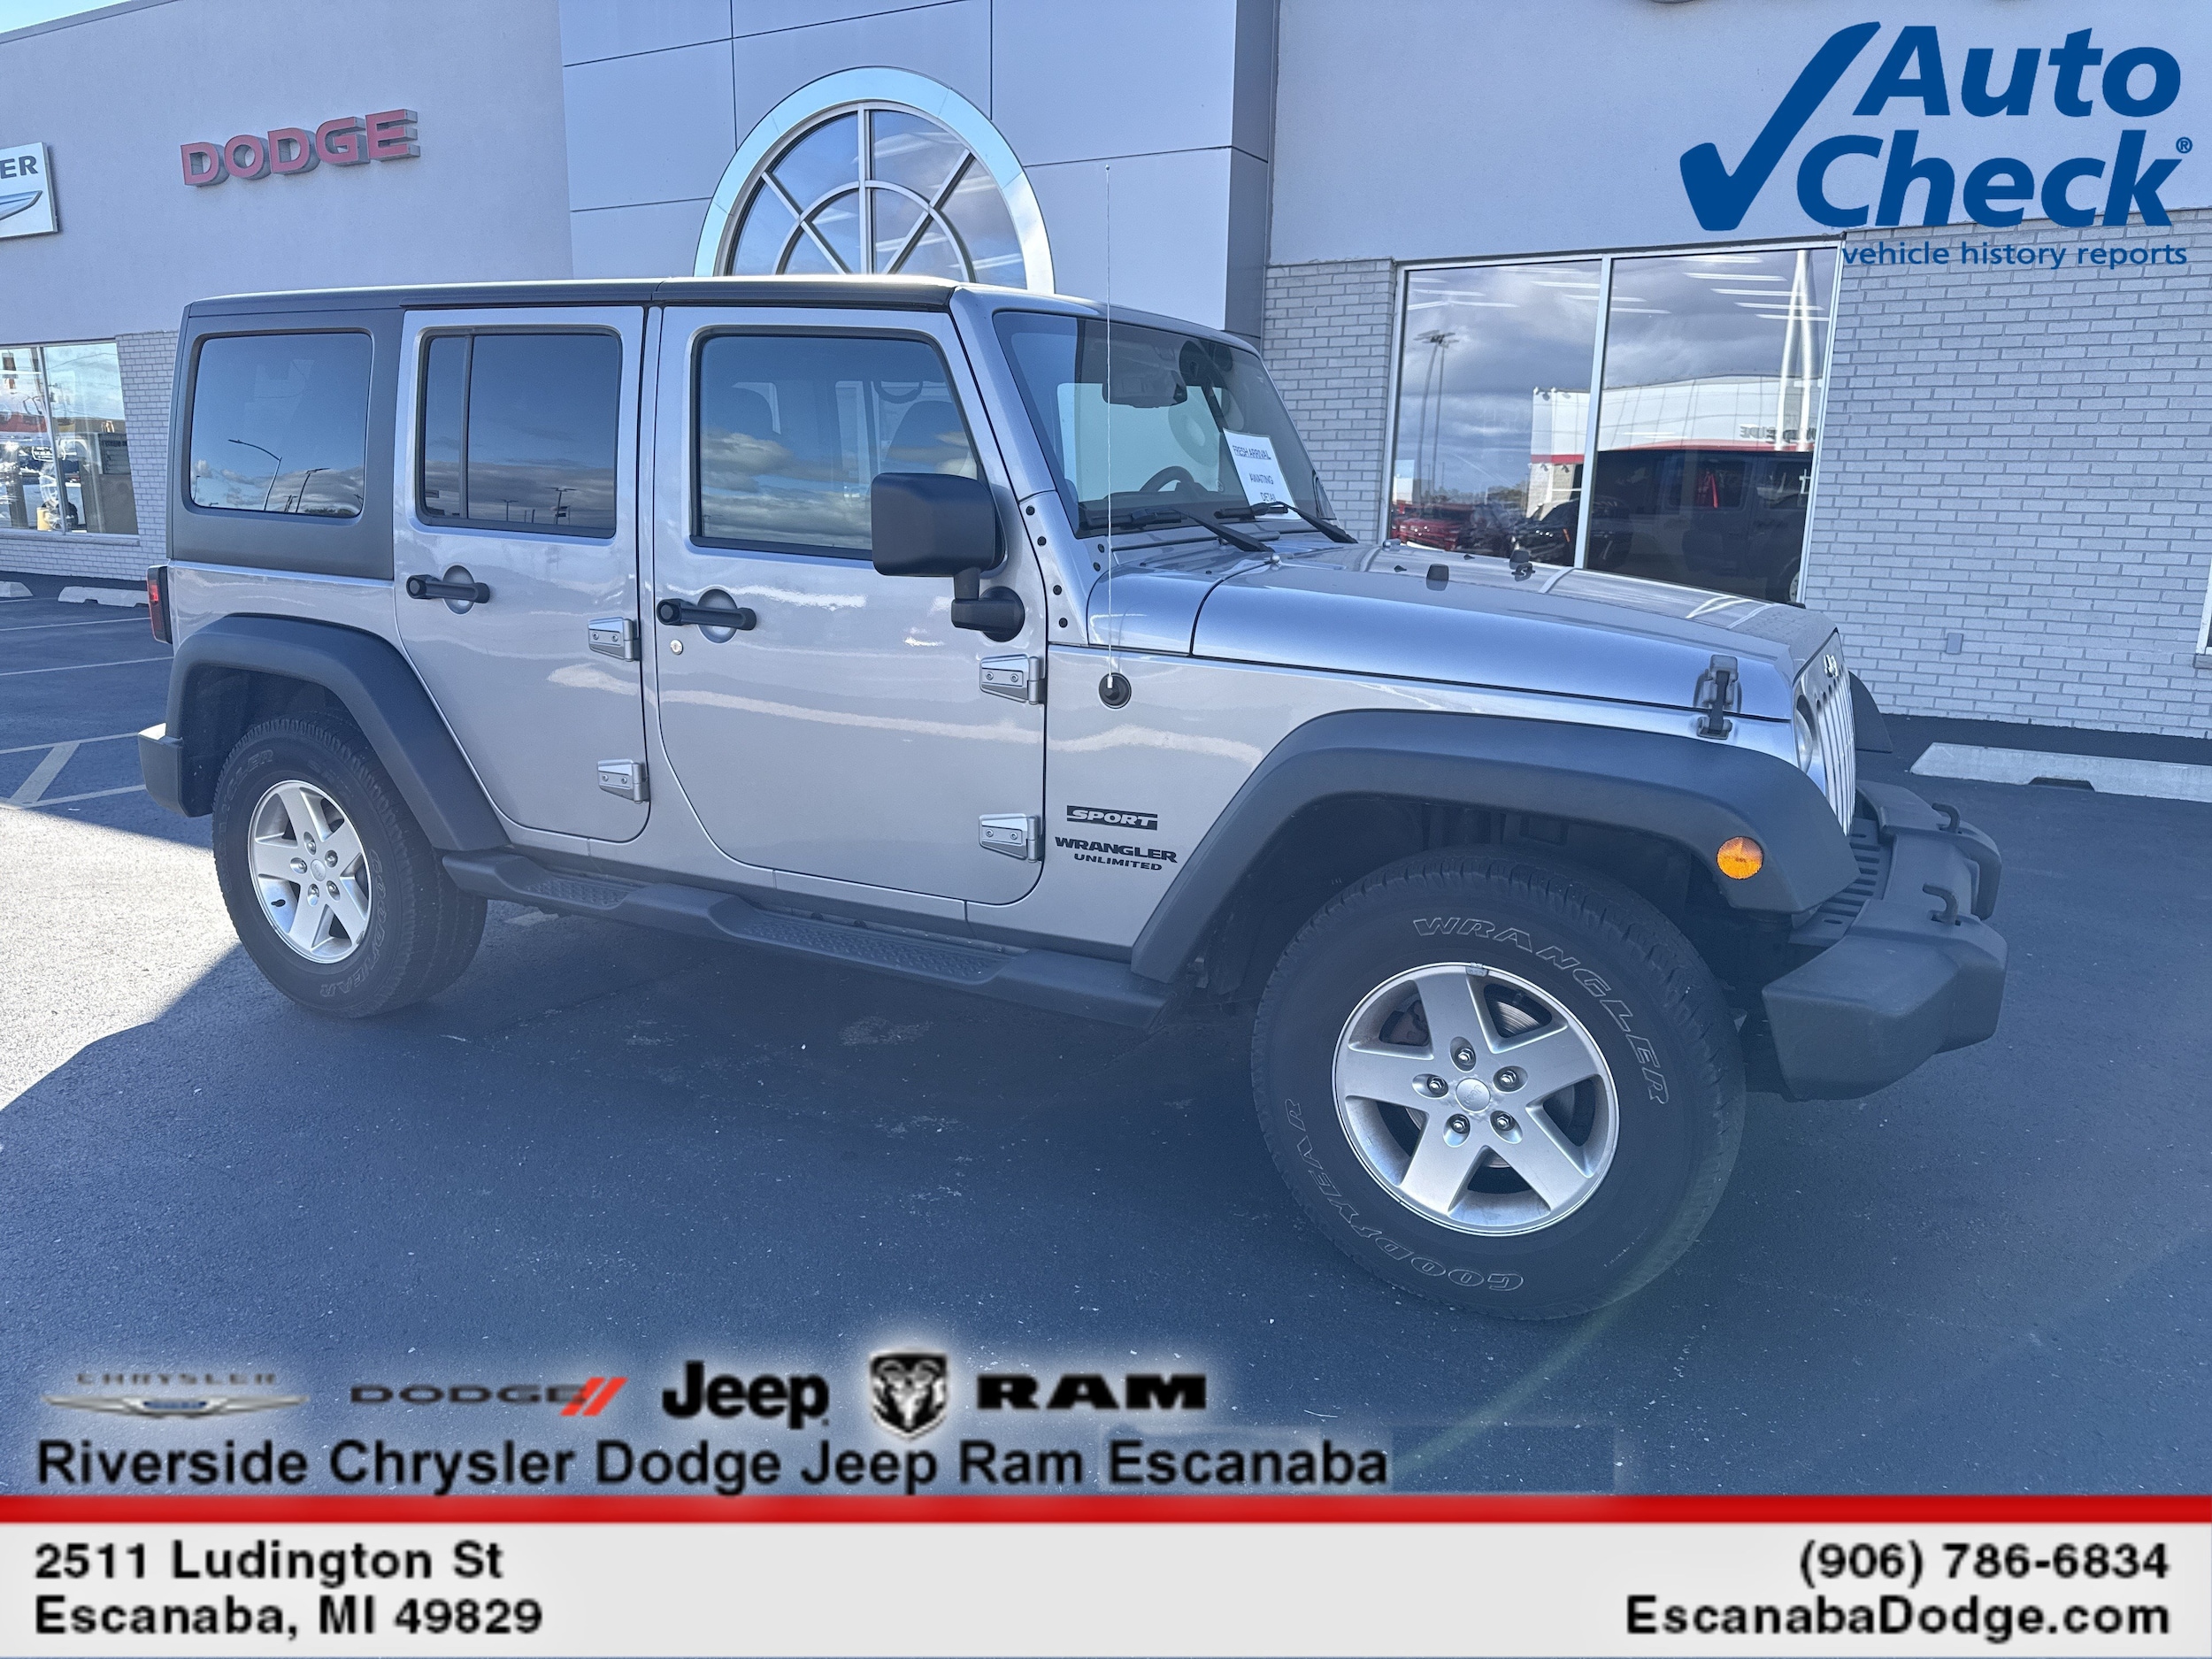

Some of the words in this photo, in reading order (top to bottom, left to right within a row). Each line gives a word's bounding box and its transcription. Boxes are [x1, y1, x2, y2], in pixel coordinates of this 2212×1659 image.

[180, 109, 420, 186] DODGE
[1068, 806, 1158, 830] SPORT
[1055, 836, 1178, 864] WRANGLER
[1073, 853, 1163, 871] UNLIMITED
[1412, 916, 1671, 1106] WRANGLER
[1283, 1097, 1525, 1292] GOODYEAR
